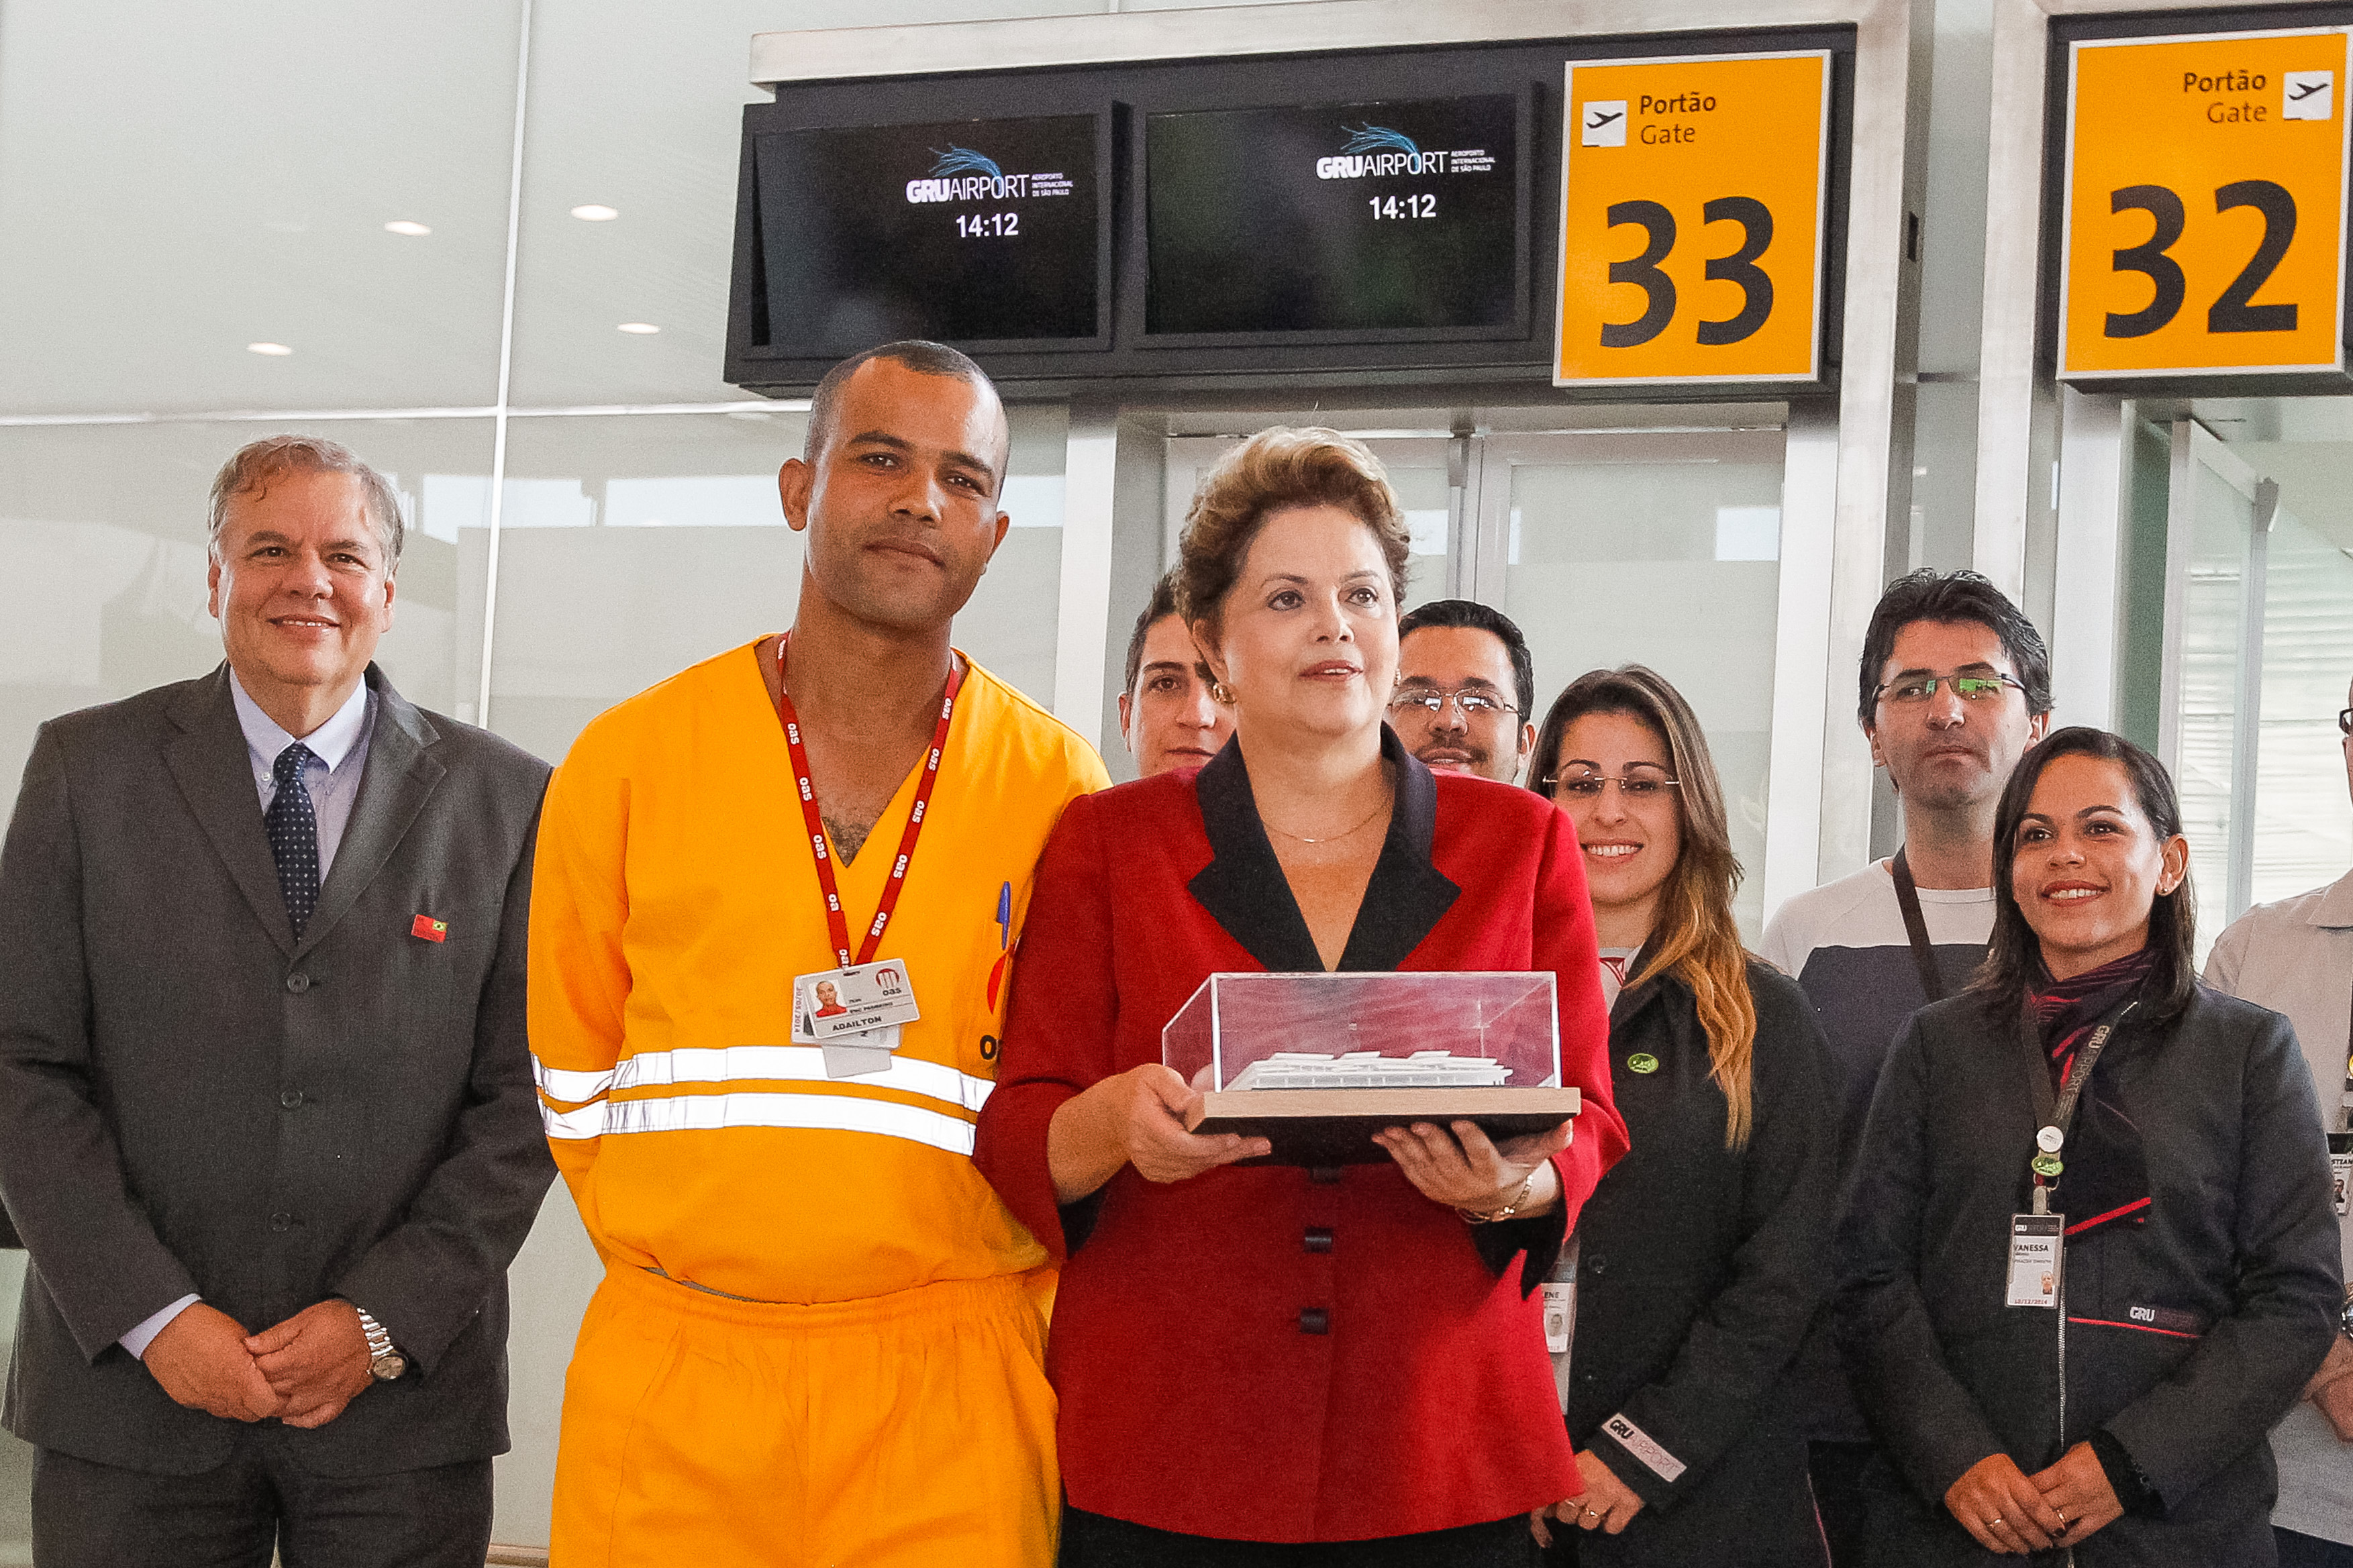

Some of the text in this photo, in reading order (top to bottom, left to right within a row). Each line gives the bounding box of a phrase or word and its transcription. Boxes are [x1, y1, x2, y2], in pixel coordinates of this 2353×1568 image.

[2184, 70, 2266, 93] Portão
[1640, 91, 1716, 115] Portão
[2207, 103, 2267, 123] Gate
[1640, 125, 1695, 145] Gate
[1369, 194, 1436, 220] 14:12
[956, 213, 1019, 238] 14:12
[2104, 180, 2298, 338] 32
[1600, 196, 1773, 348] 33
[787, 723, 800, 745] oas
[928, 748, 940, 771] oas
[799, 777, 812, 801] oas
[912, 800, 925, 823] oas
[813, 835, 827, 859] oas
[893, 854, 908, 878] oas
[828, 894, 839, 912] oa
[871, 912, 887, 937] oas
[839, 949, 850, 968] oa
[832, 1016, 882, 1031] ADAILTON
[2013, 1244, 2049, 1252] VANESSA
